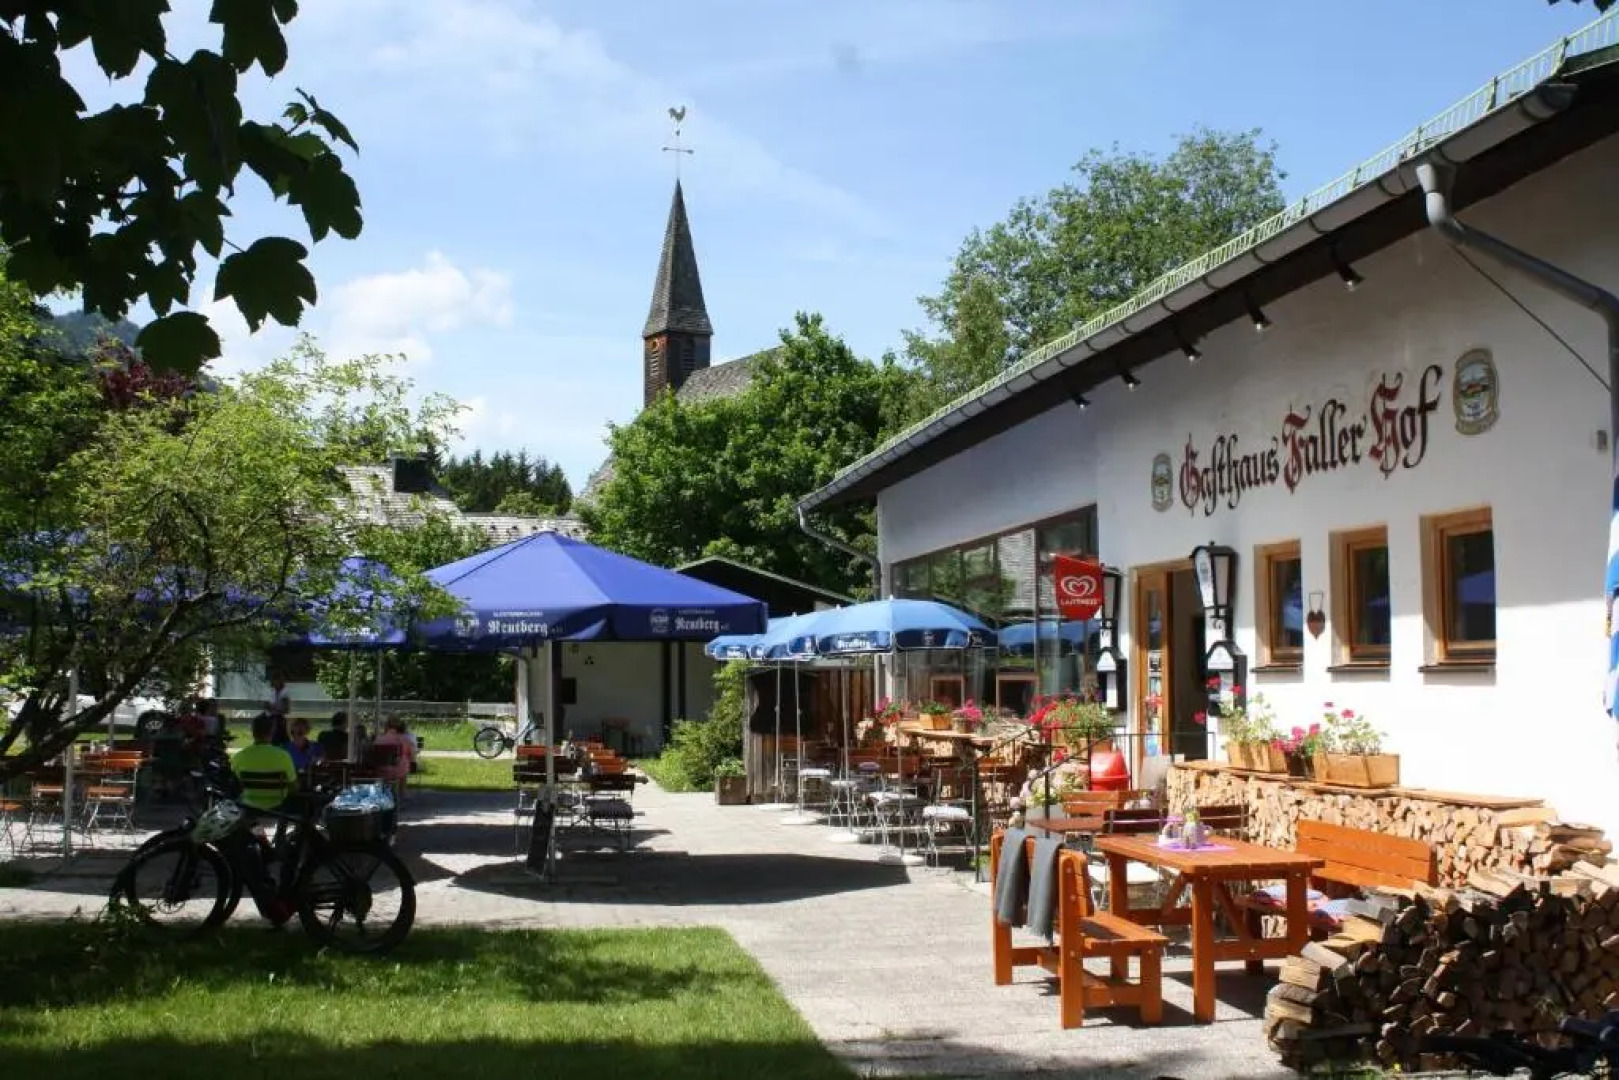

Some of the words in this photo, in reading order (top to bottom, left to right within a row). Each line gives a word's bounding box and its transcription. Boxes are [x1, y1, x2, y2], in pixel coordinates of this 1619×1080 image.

[1180, 432, 1280, 517] Gasthaus
[1282, 399, 1367, 495] Faller
[1368, 364, 1443, 480] Hof
